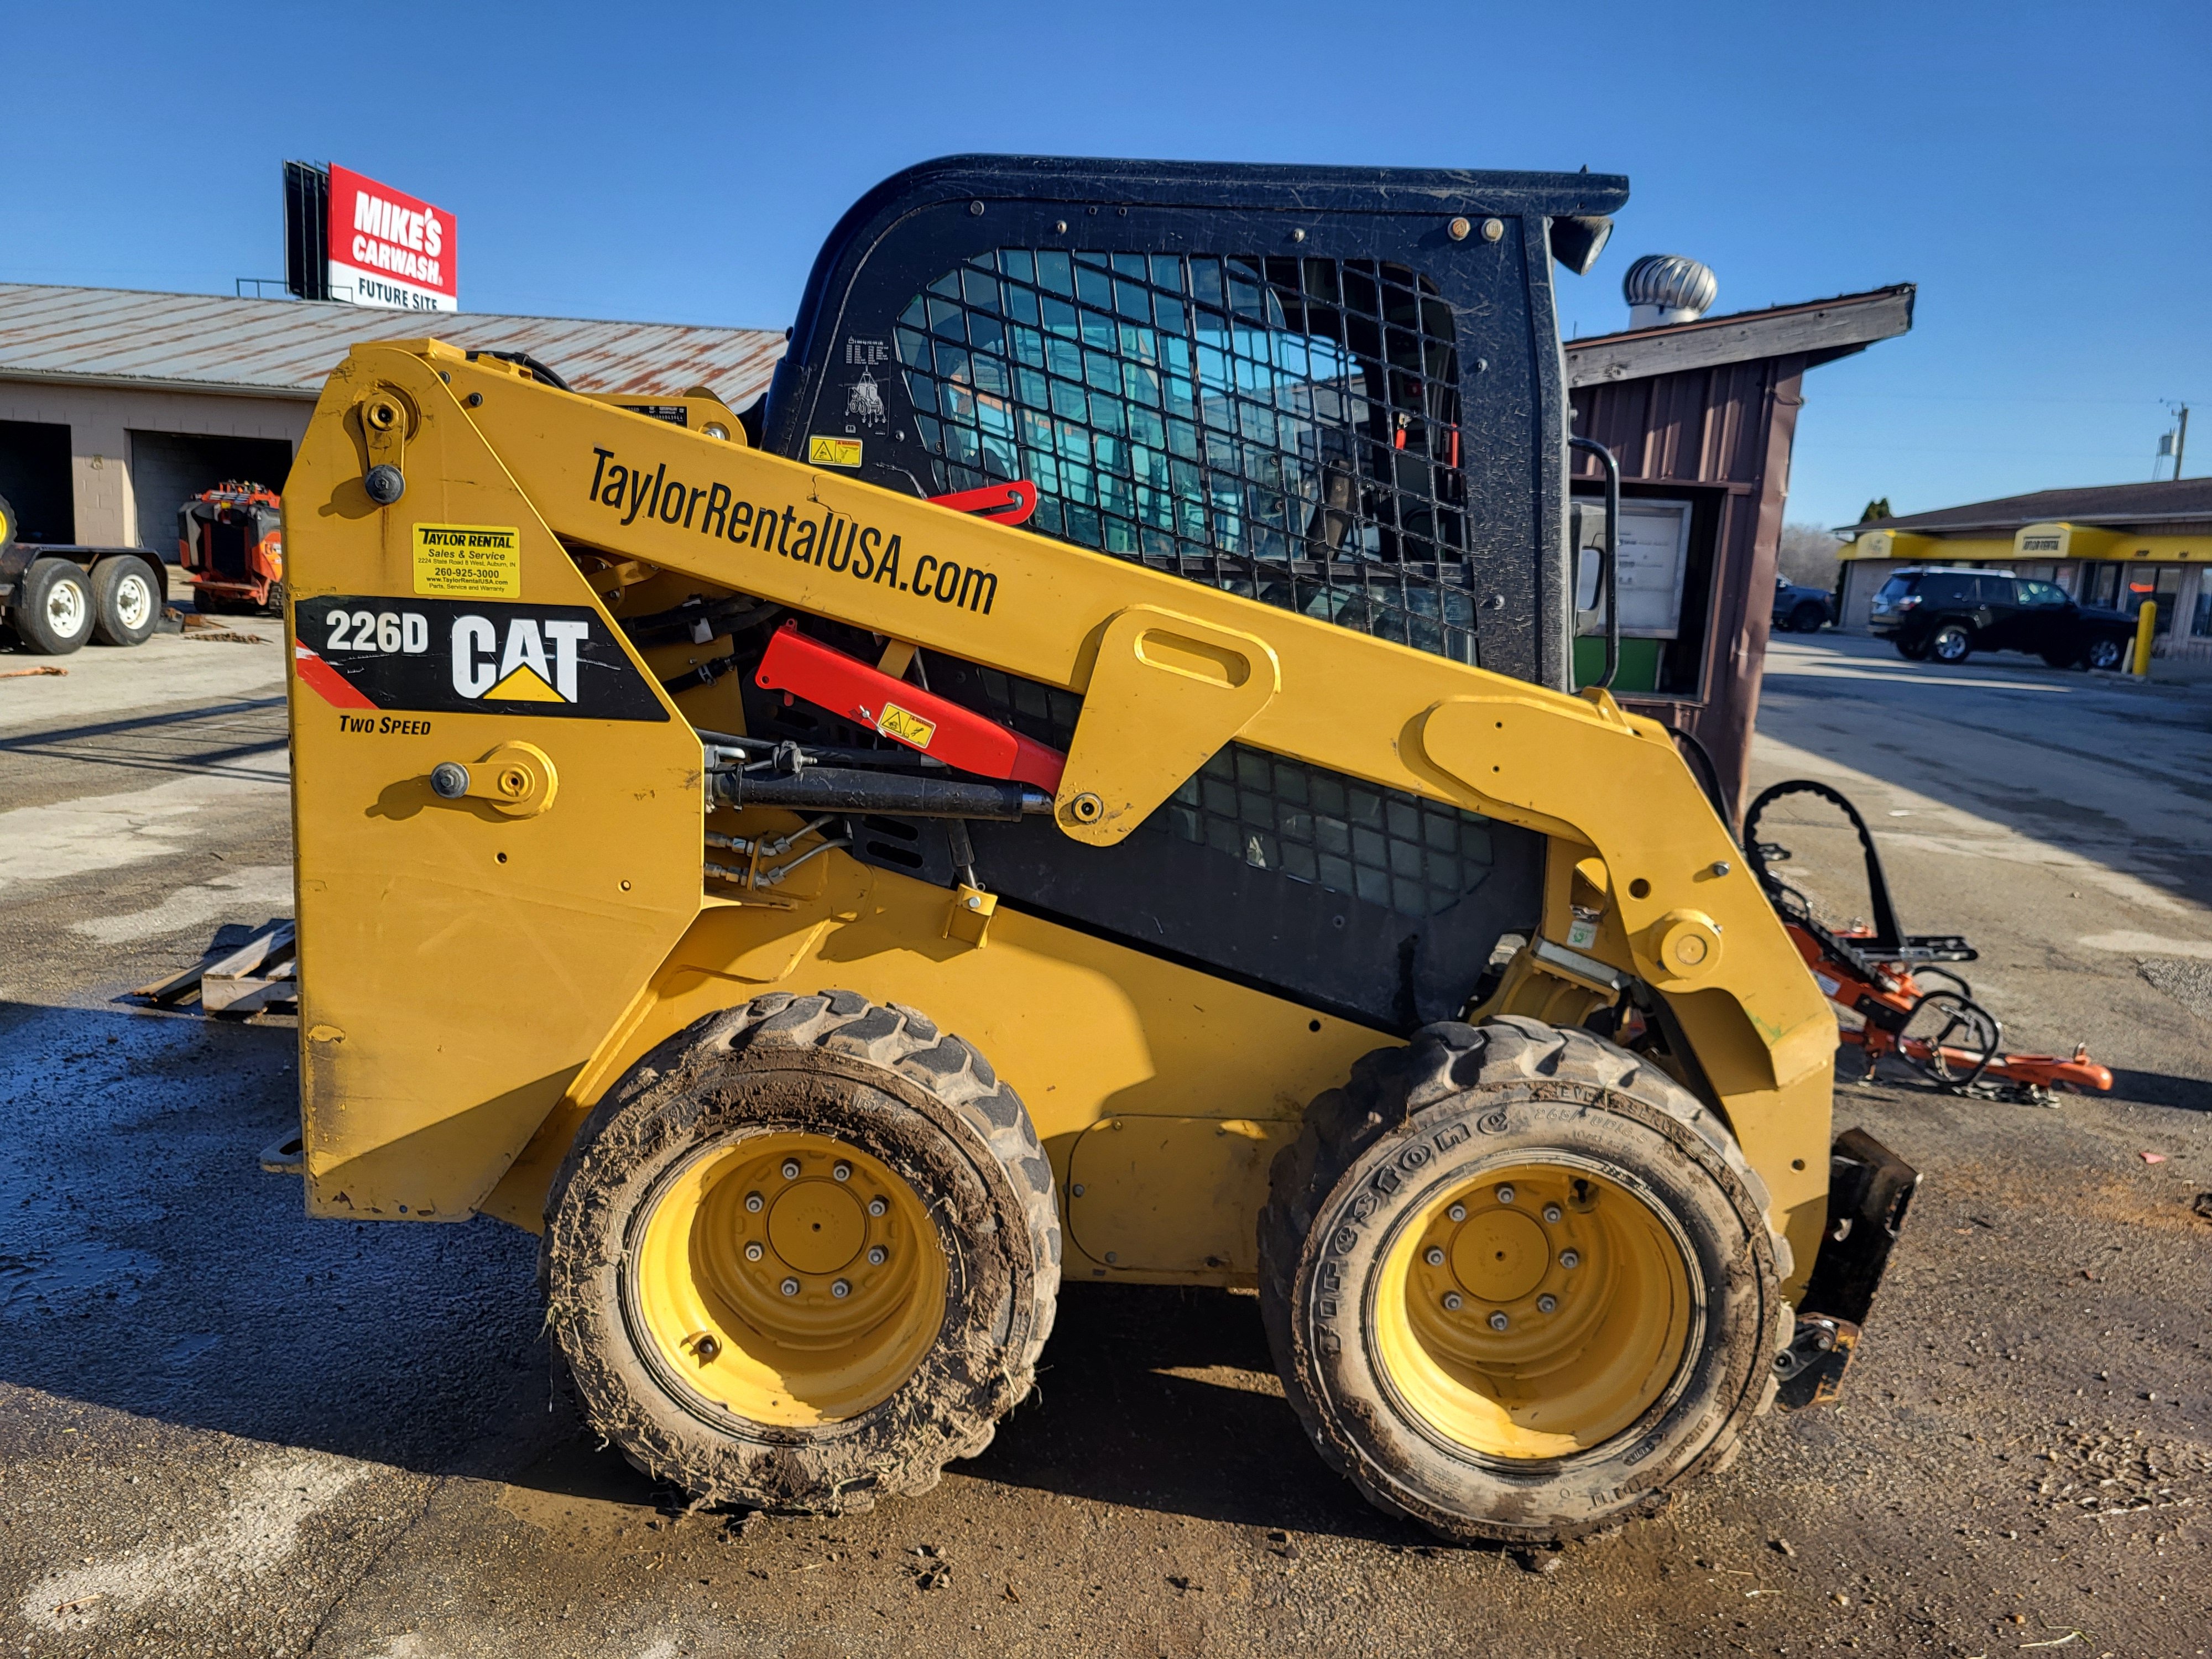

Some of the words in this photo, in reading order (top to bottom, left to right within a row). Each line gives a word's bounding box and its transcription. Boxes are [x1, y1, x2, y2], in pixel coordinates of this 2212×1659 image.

[353, 190, 443, 258] MIKE'S
[352, 234, 441, 286] CARWASH
[359, 277, 409, 308] FUTURE
[412, 293, 438, 309] SITE
[422, 529, 465, 546] TAYLOR
[468, 535, 512, 549] RENTAL
[589, 446, 999, 615] TaylorRentalUSA.com
[427, 549, 455, 559] Sales
[458, 550, 465, 559] &
[468, 551, 505, 561] Service
[435, 567, 499, 578] 260-925-3000
[426, 577, 508, 586] www.TaylorRentalUSA.com
[326, 610, 429, 654] 226D
[451, 614, 589, 703] CAT
